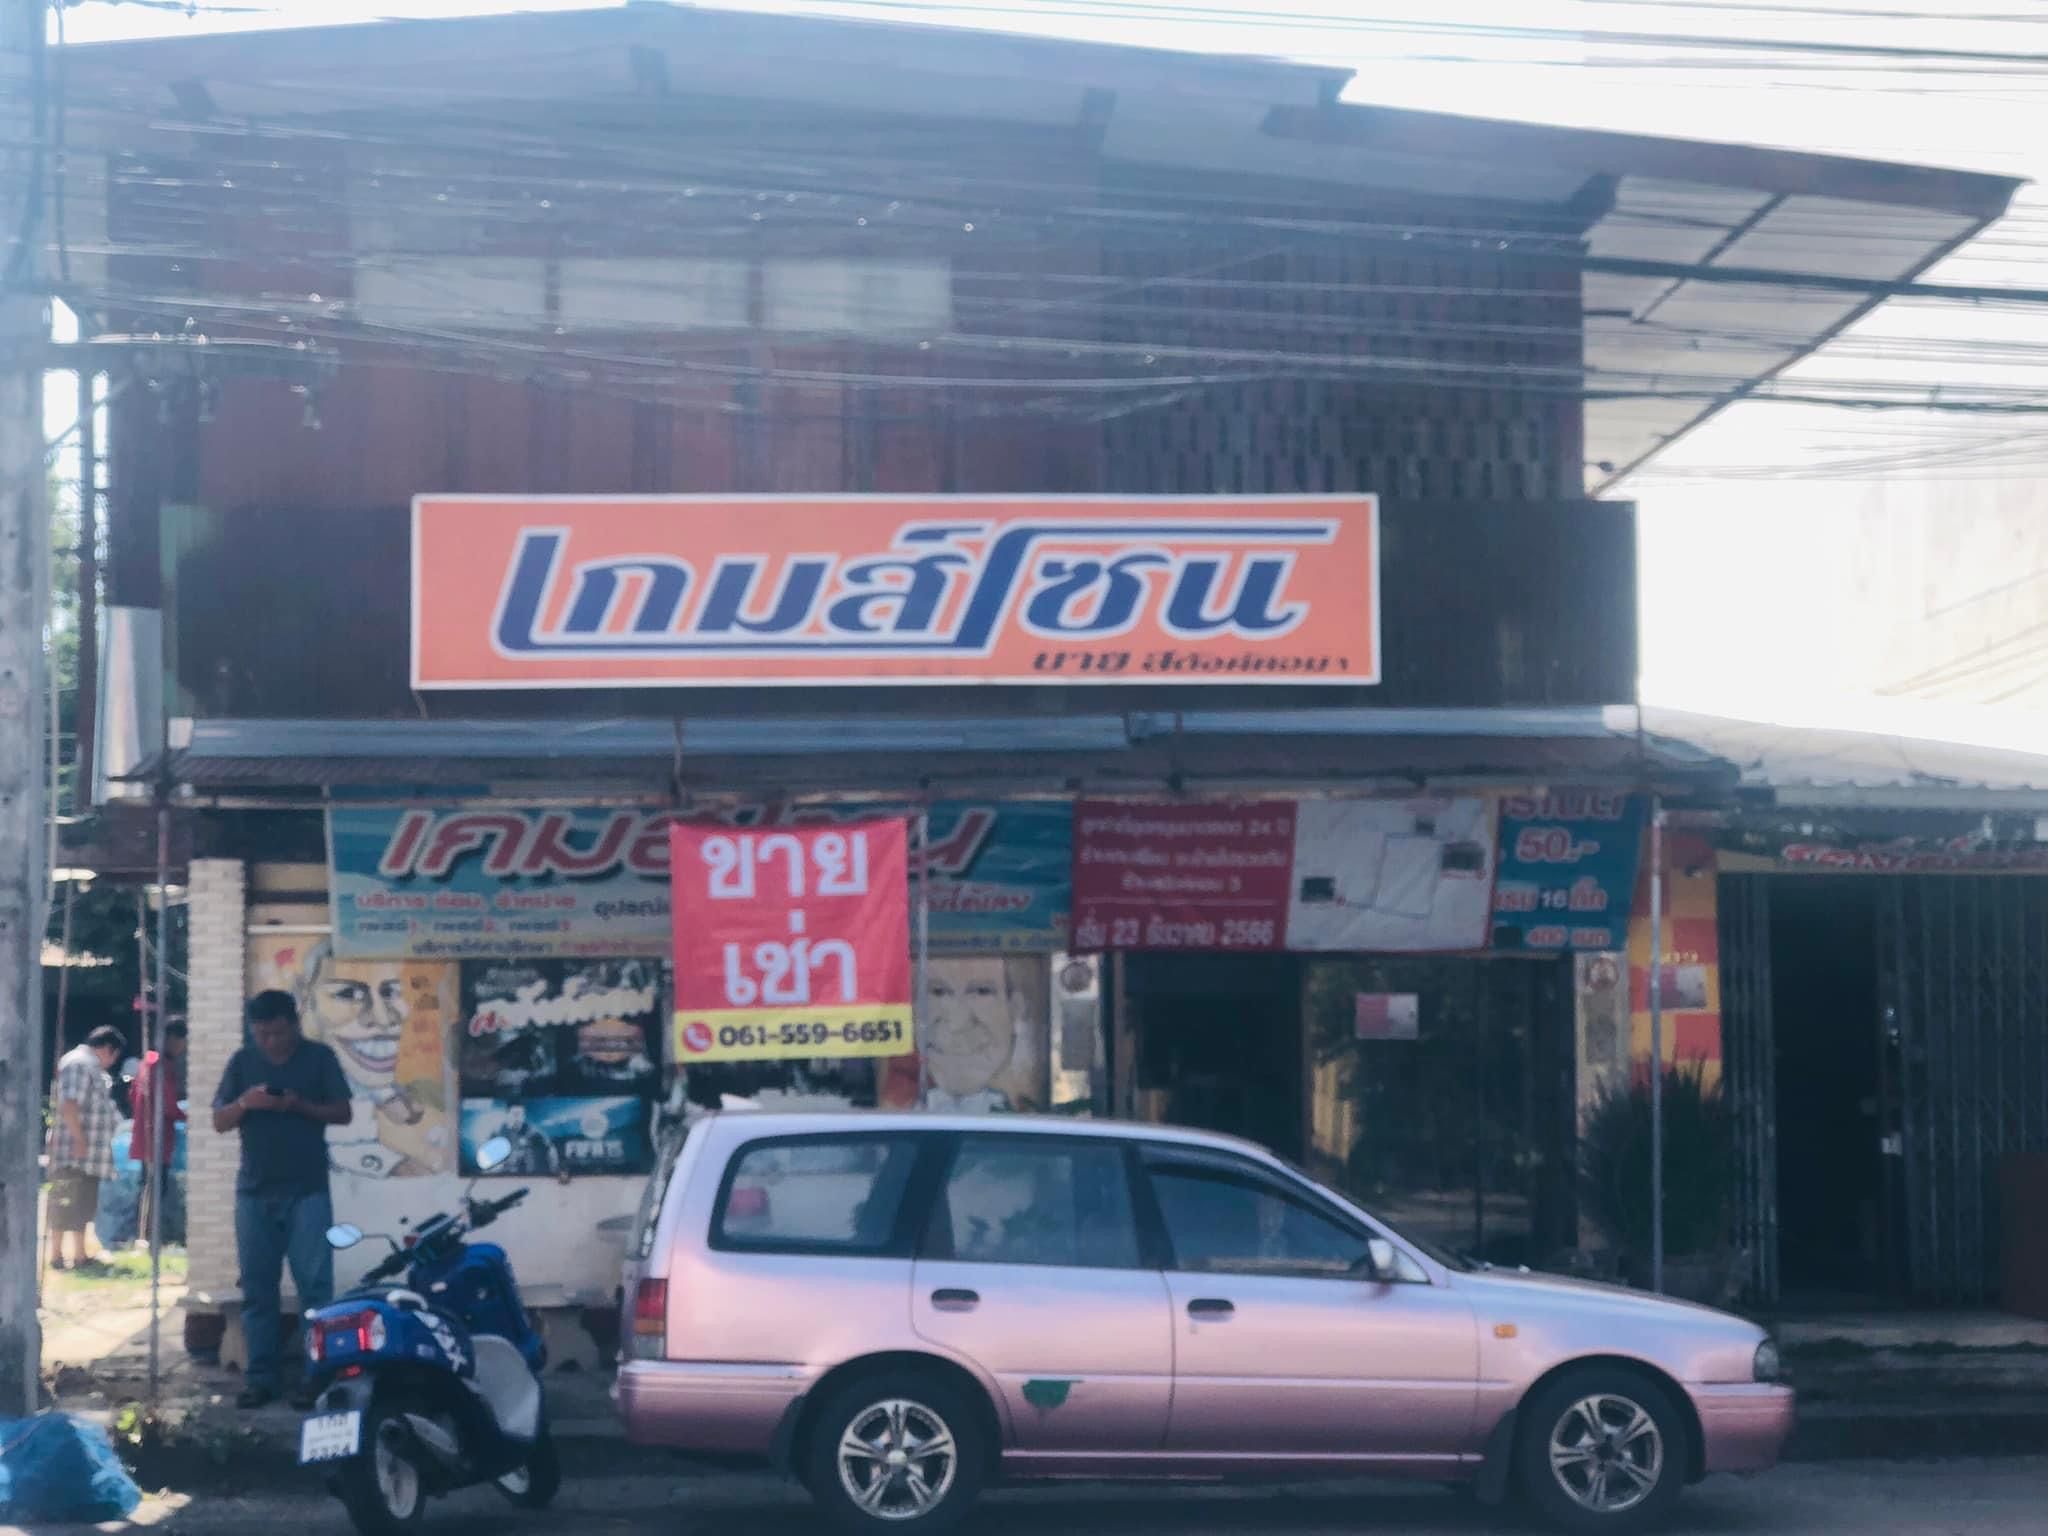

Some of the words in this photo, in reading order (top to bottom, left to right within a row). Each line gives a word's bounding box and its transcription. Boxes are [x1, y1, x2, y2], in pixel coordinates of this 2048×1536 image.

[492, 518, 1340, 657] เกมส์โซน
[700, 832, 869, 899] ขาย
[723, 909, 859, 1006] เช่า
[718, 1020, 903, 1047] 061-559-6651
